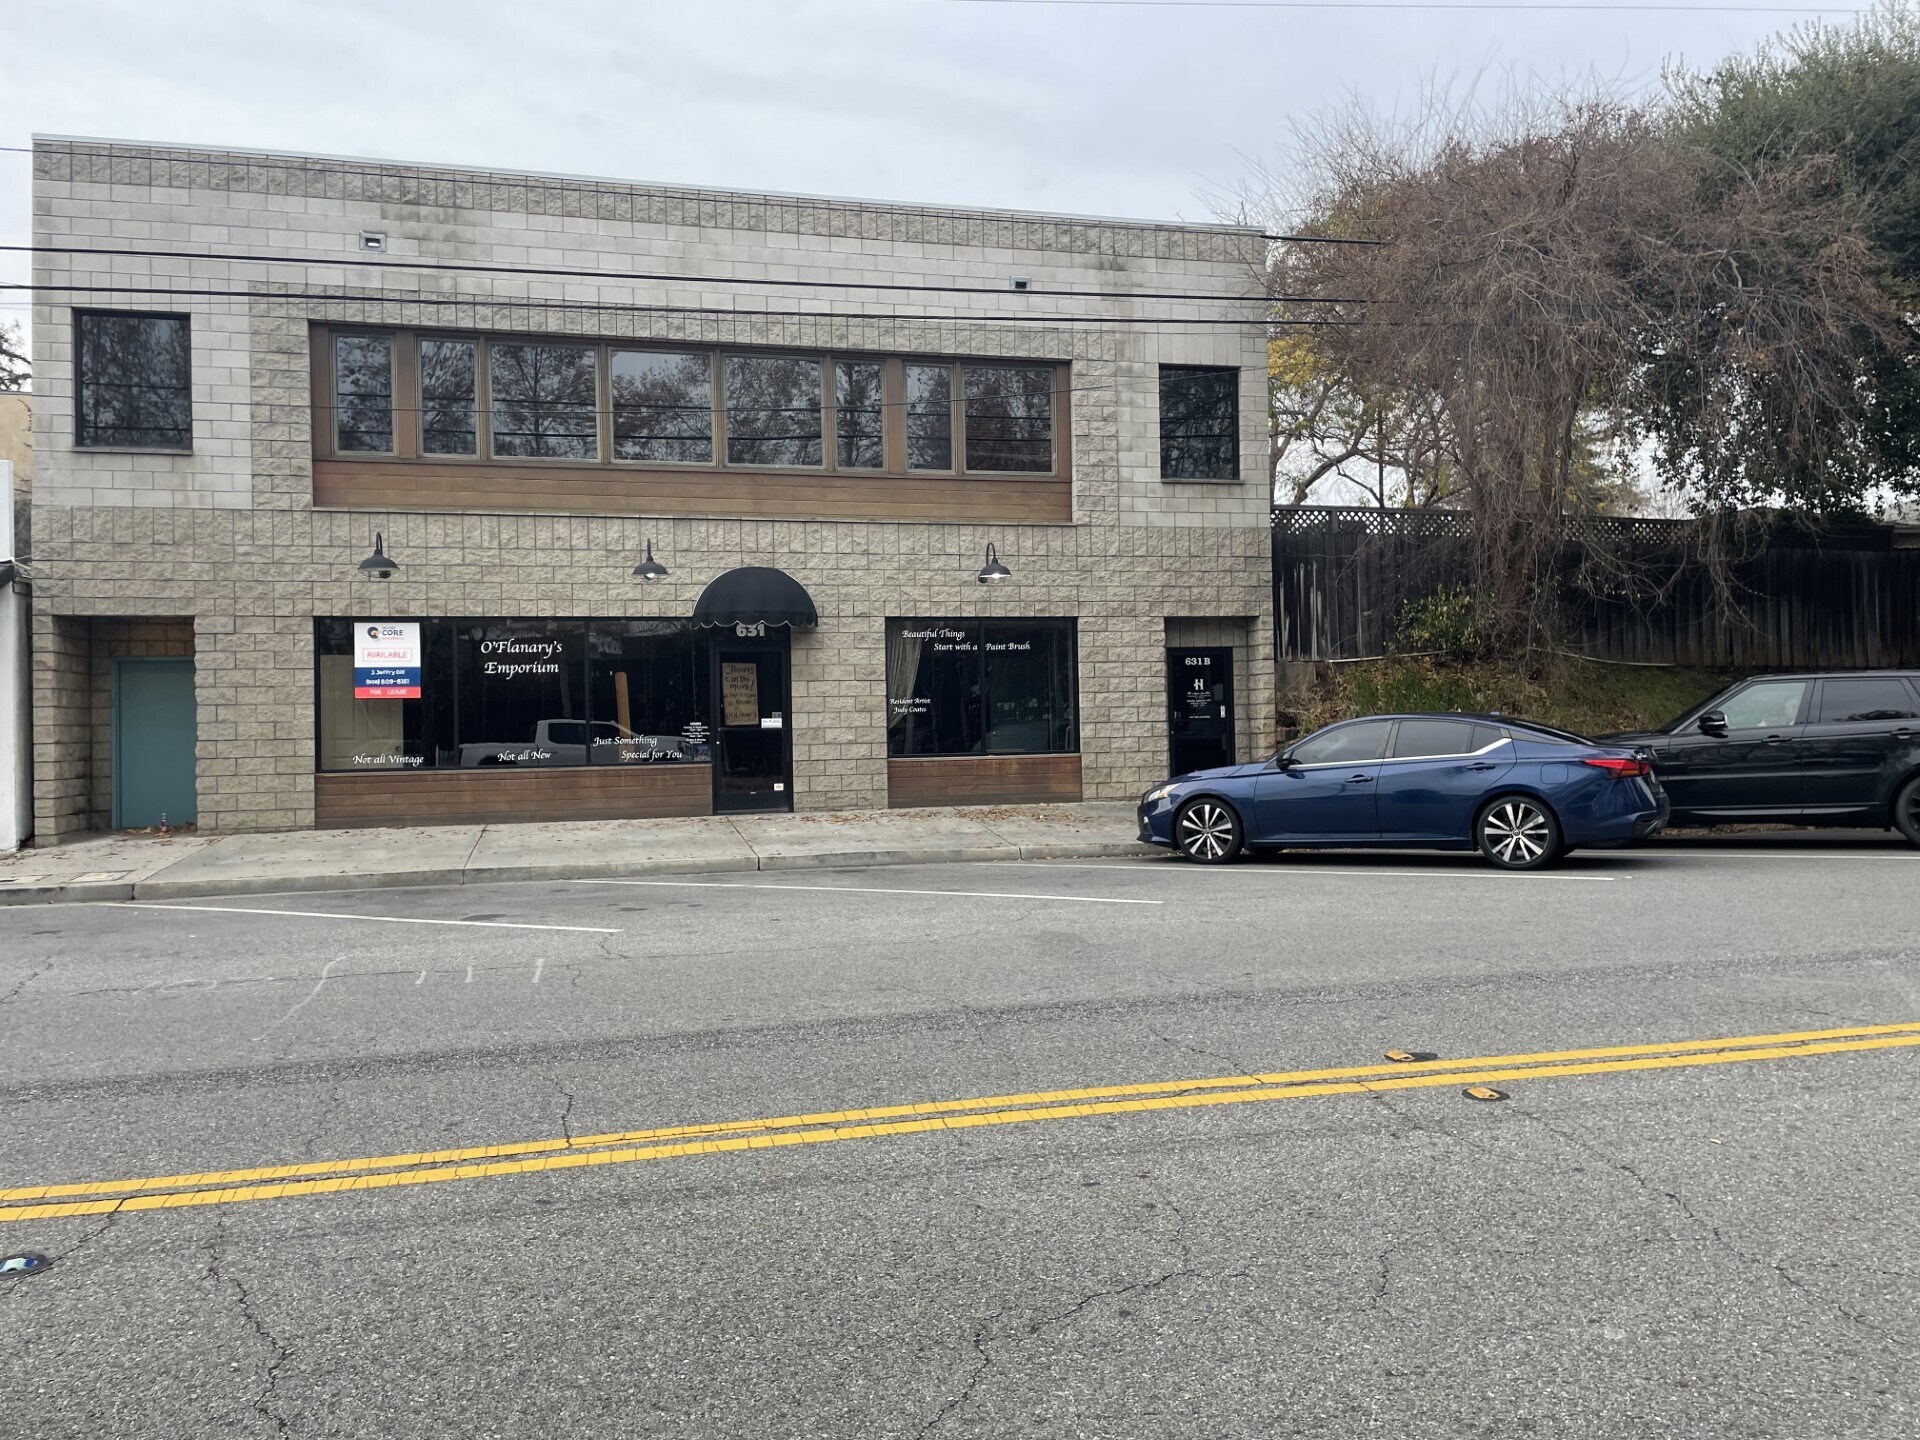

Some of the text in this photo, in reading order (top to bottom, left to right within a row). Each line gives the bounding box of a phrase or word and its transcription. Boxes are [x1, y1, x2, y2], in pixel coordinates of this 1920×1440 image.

[736, 623, 765, 637] 631
[901, 628, 965, 642] Beautiful Things
[480, 638, 562, 659] O'Flanary's
[933, 640, 1031, 651] Start with a Paint Brush
[366, 651, 408, 659] AVAILABLE
[484, 661, 559, 680] Emporium
[892, 705, 908, 716] Judy
[592, 734, 658, 747] Just Something
[352, 753, 425, 767] Not all Vintage
[497, 748, 552, 762] Not all New
[621, 748, 683, 762] Special for You
